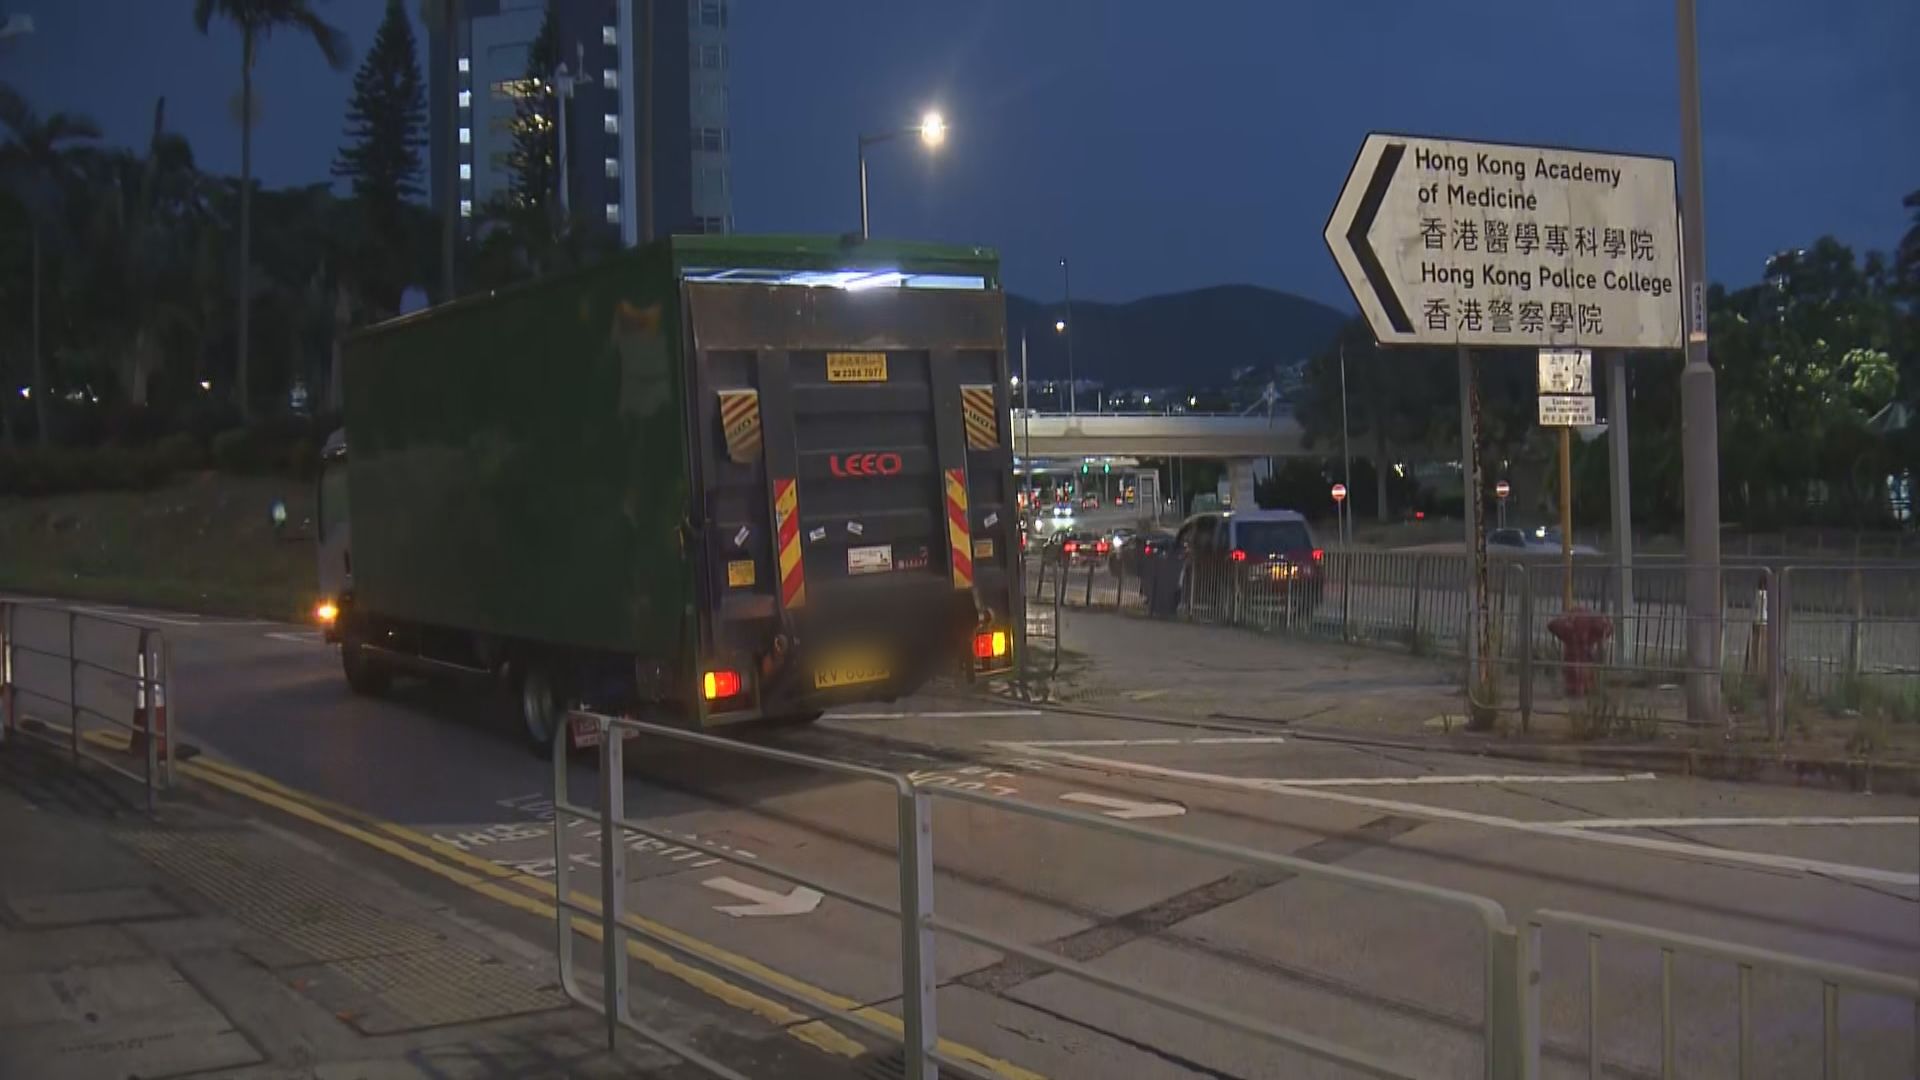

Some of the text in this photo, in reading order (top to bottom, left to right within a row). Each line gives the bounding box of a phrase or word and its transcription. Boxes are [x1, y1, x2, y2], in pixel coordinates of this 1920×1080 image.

[1416, 147, 1621, 188] Hong Kong Academy
[1418, 183, 1538, 211] of Medicine
[1419, 217, 1655, 262] 香港醫學專科學院
[1421, 262, 1673, 297] Hong Kong Police College
[1424, 298, 1604, 335] 香港警察學院
